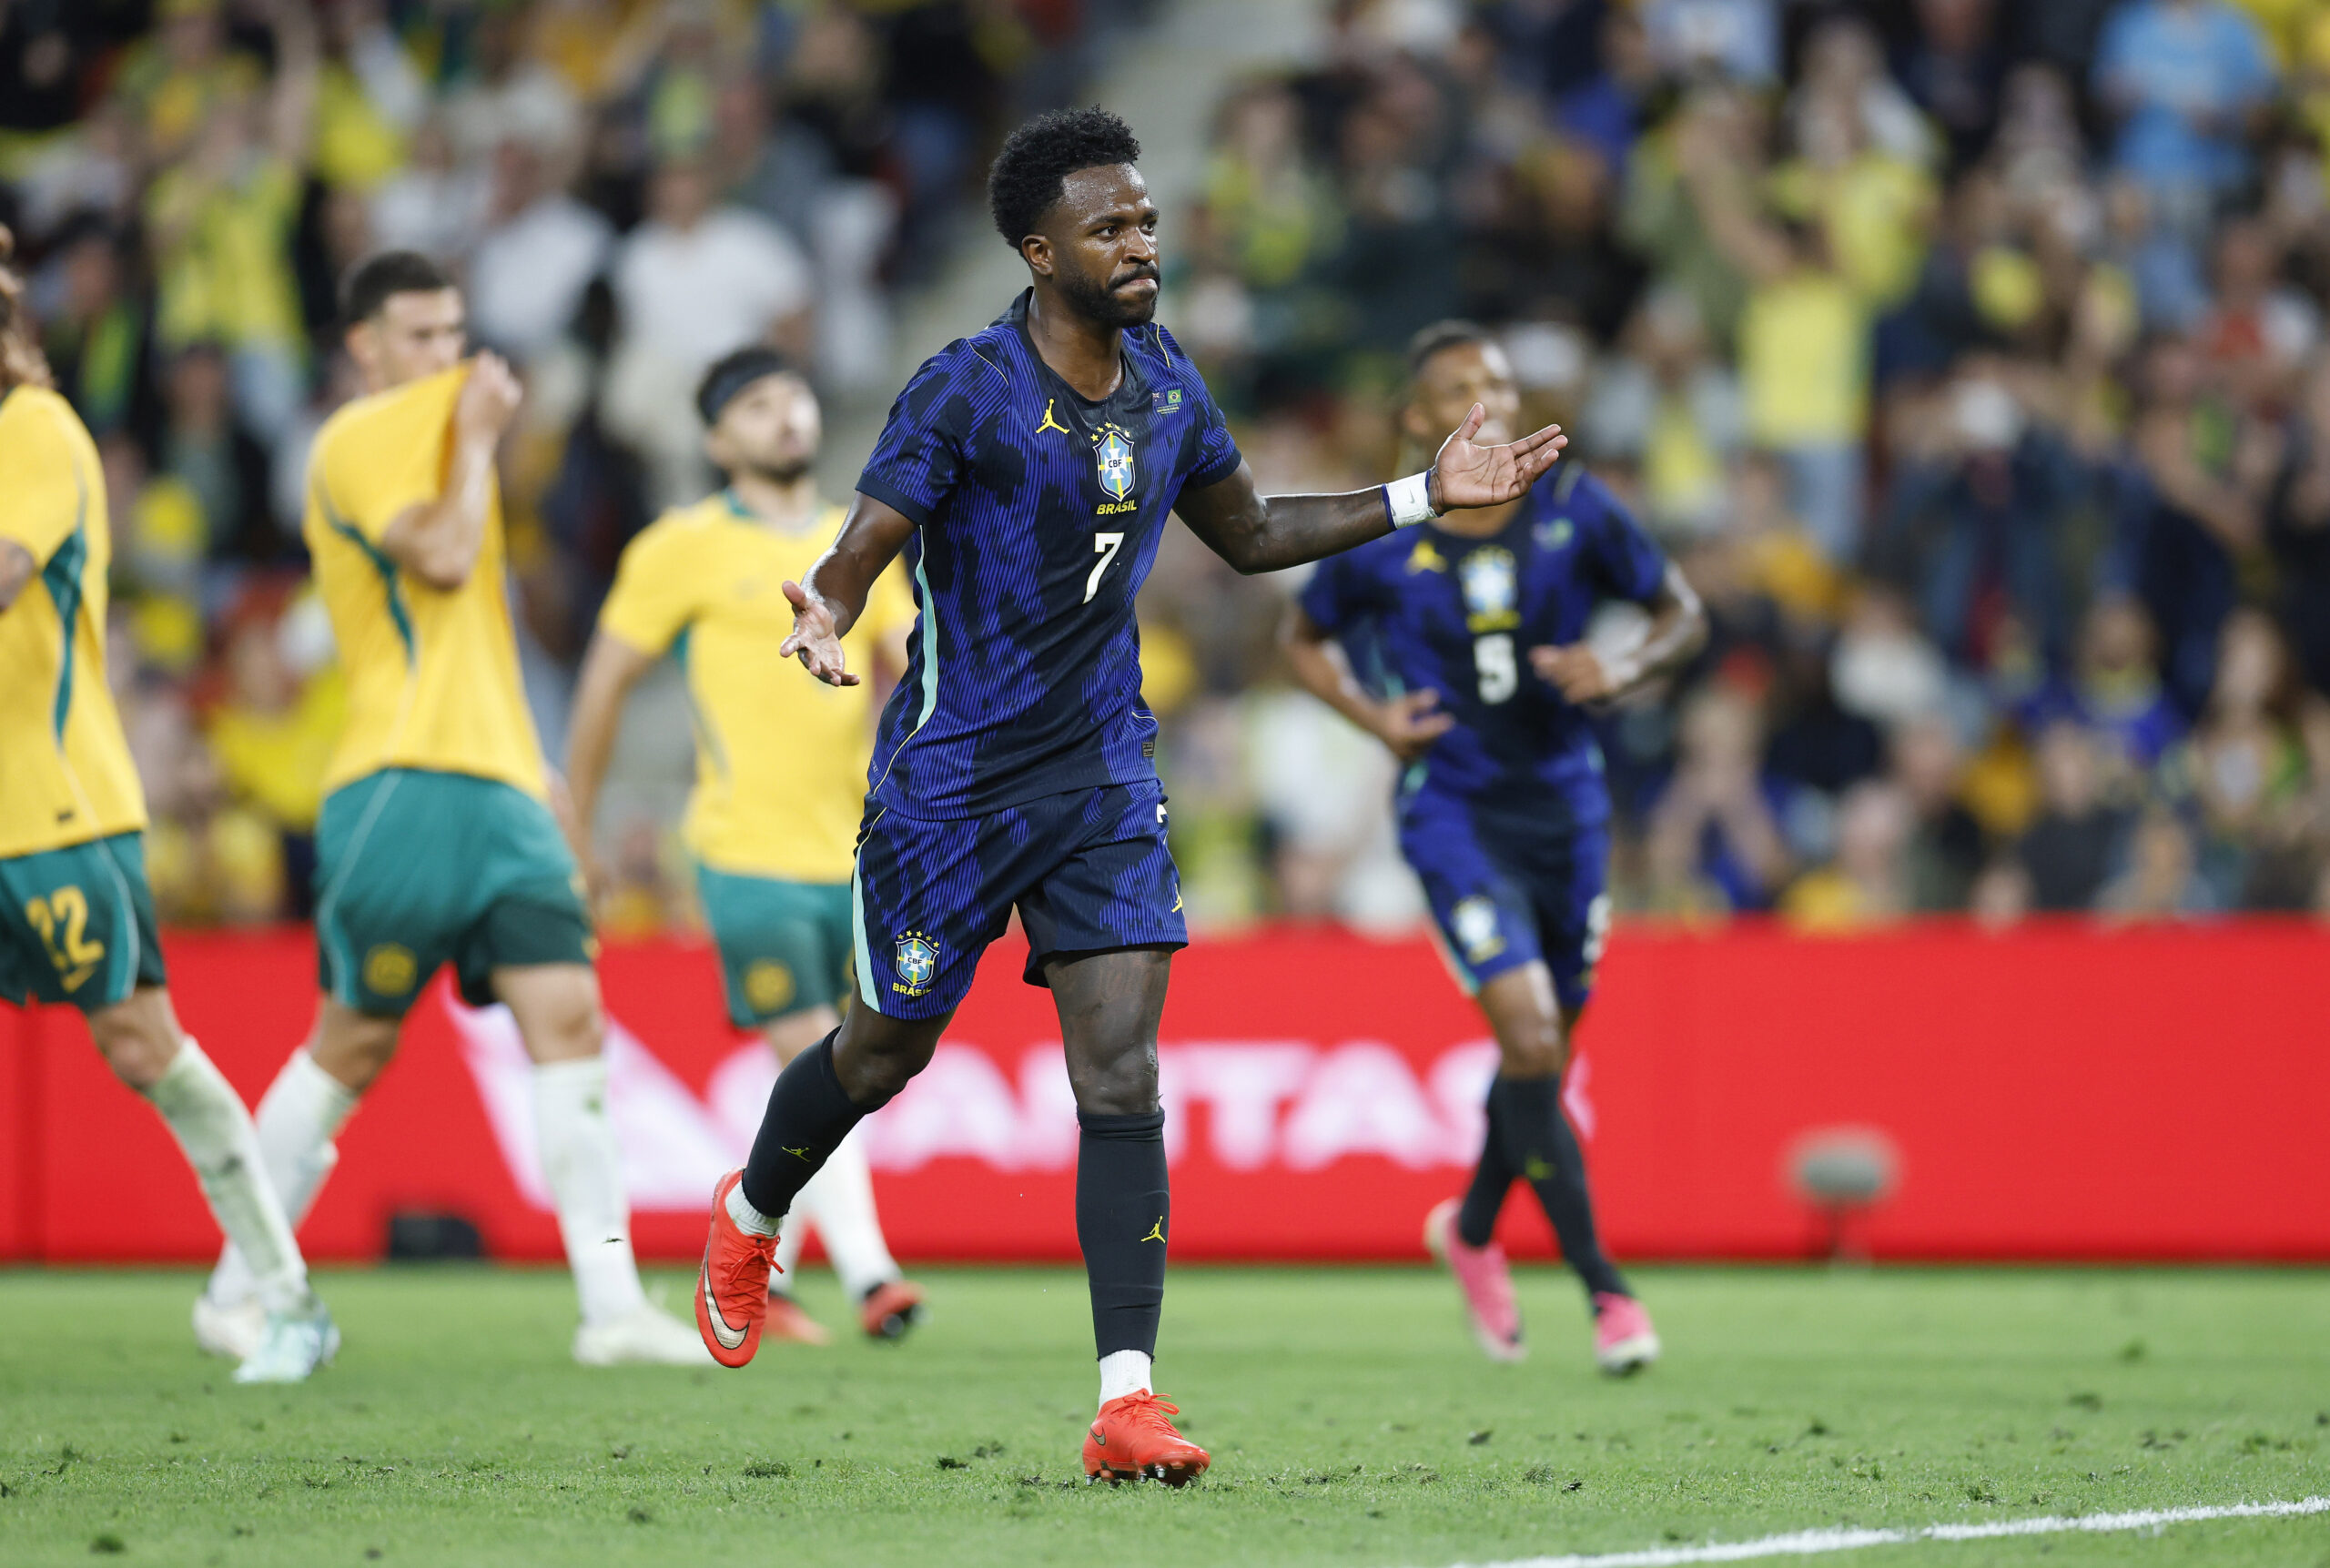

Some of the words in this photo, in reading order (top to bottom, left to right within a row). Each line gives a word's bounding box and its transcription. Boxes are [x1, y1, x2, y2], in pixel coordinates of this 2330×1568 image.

[1108, 459, 1122, 469] CBF
[1096, 499, 1138, 515] BRASIL
[1082, 532, 1125, 604] 7
[1474, 634, 1517, 704] 5
[907, 956, 922, 965] CBF
[893, 982, 932, 996] BRASIL
